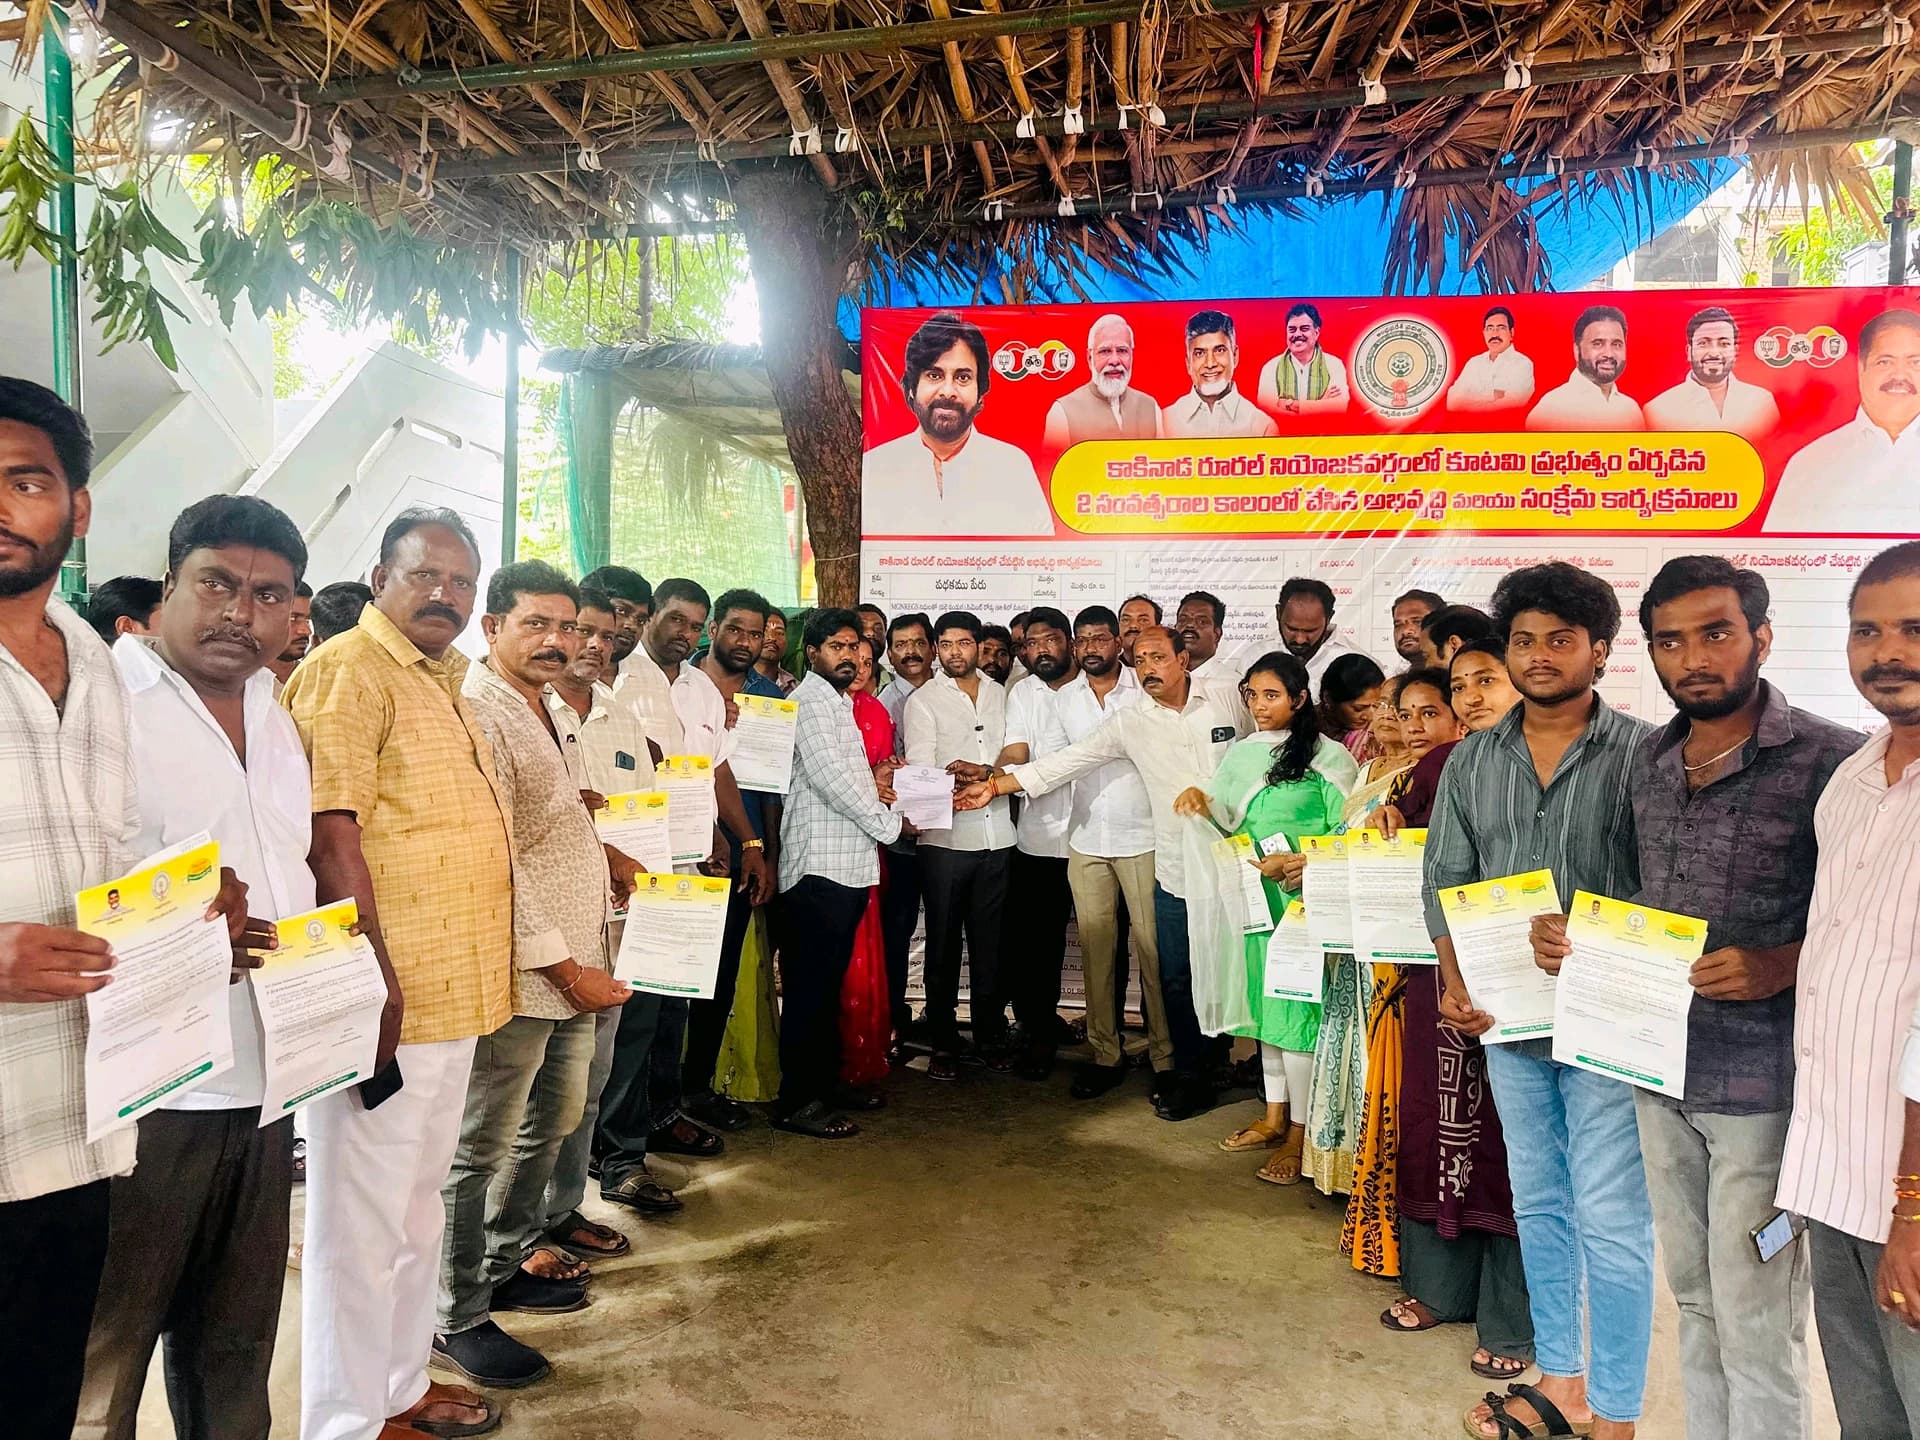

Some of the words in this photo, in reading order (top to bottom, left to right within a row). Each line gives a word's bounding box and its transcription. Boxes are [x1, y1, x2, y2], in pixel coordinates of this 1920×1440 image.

[1107, 456, 1193, 478] కాకినాడ
[1198, 453, 1264, 477] రూరల్
[1270, 448, 1440, 483] నియోజకవర్గంలో
[1446, 449, 1525, 473] కూటమి
[1531, 449, 1622, 478] ప్రభుత్వం
[1628, 448, 1706, 478] ఏర్పడిన
[1077, 494, 1091, 513] 2
[1096, 494, 1209, 519] సంవత్సరాల
[1214, 488, 1301, 513] కాలంలో
[1305, 486, 1359, 512] చేసిన
[1364, 488, 1447, 519] అభివృద్ధి
[1452, 490, 1514, 510] మరియు
[1520, 485, 1596, 516] సంక్షేమ
[1601, 488, 1738, 518] కార్యక్రమాలు
[911, 556, 935, 566] రూరల్
[1749, 554, 1827, 572] నియోజకవర్గంలో
[1829, 553, 1862, 573] చేపట్టిన
[970, 577, 987, 590] పేరు
